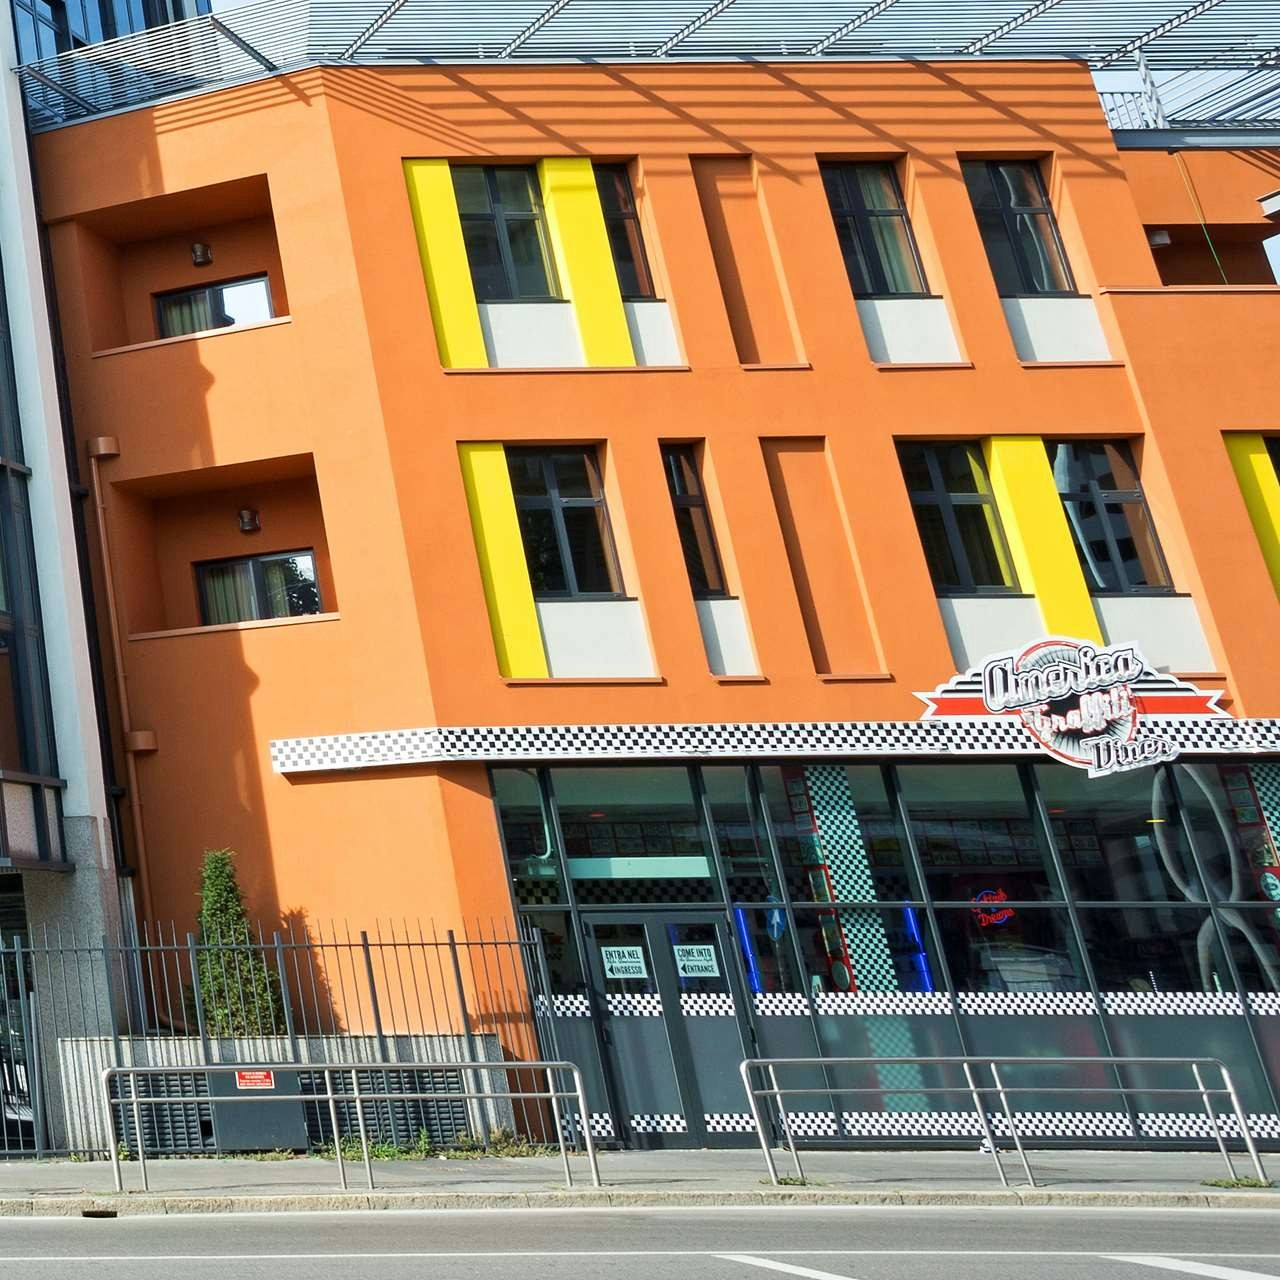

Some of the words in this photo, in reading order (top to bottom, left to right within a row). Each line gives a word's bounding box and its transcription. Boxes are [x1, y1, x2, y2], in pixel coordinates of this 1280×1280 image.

[605, 950, 627, 960] ENTRA
[627, 949, 641, 960] NEL
[677, 948, 696, 958] COME
[696, 948, 712, 958] INTO
[614, 965, 643, 975] INGRESSO
[687, 965, 715, 973] ENTRANCE
